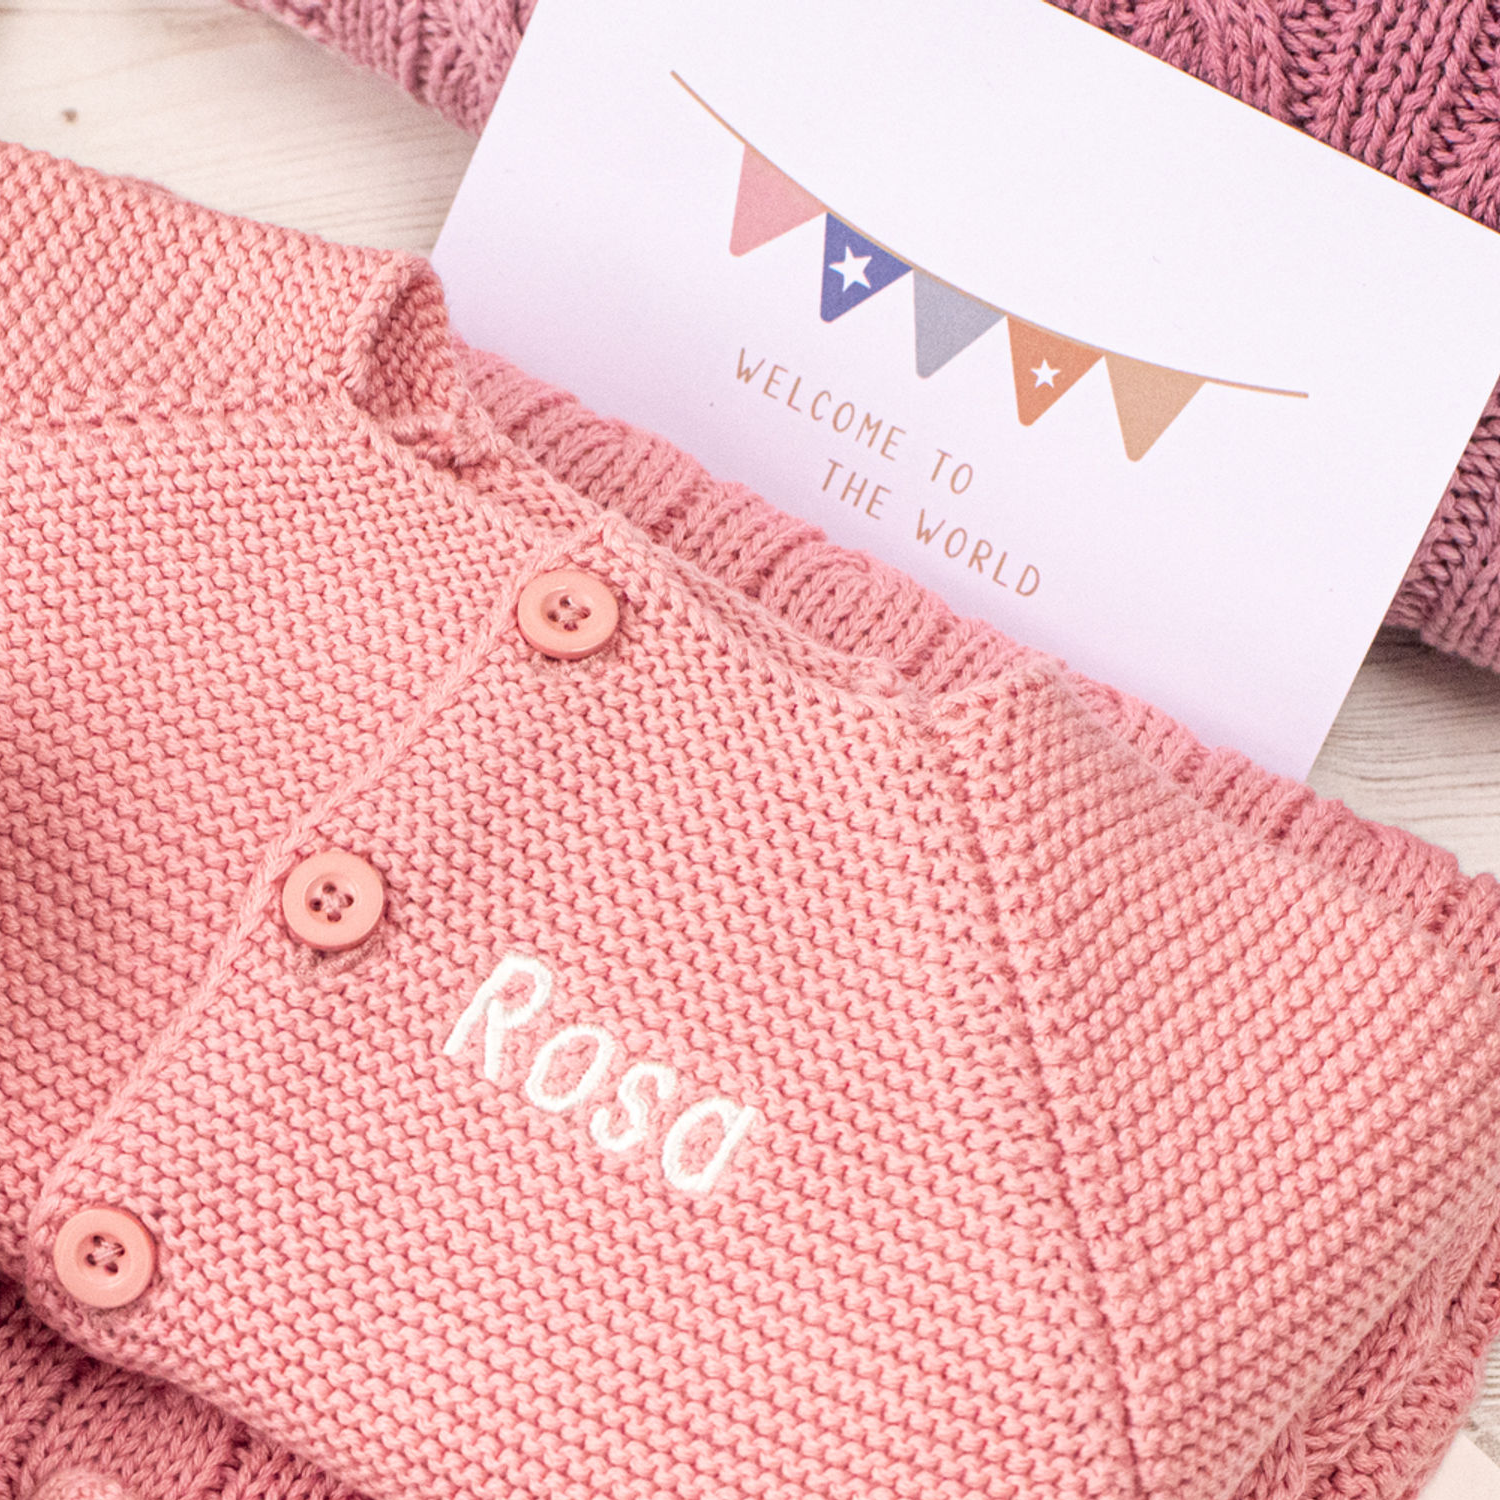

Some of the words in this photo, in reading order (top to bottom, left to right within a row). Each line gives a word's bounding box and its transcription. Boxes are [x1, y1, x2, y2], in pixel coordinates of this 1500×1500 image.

[736, 347, 907, 462] WELCOME
[930, 448, 974, 495] TO
[821, 458, 892, 520] THE
[915, 508, 1041, 597] WORLD
[442, 953, 759, 1192] Rosa
